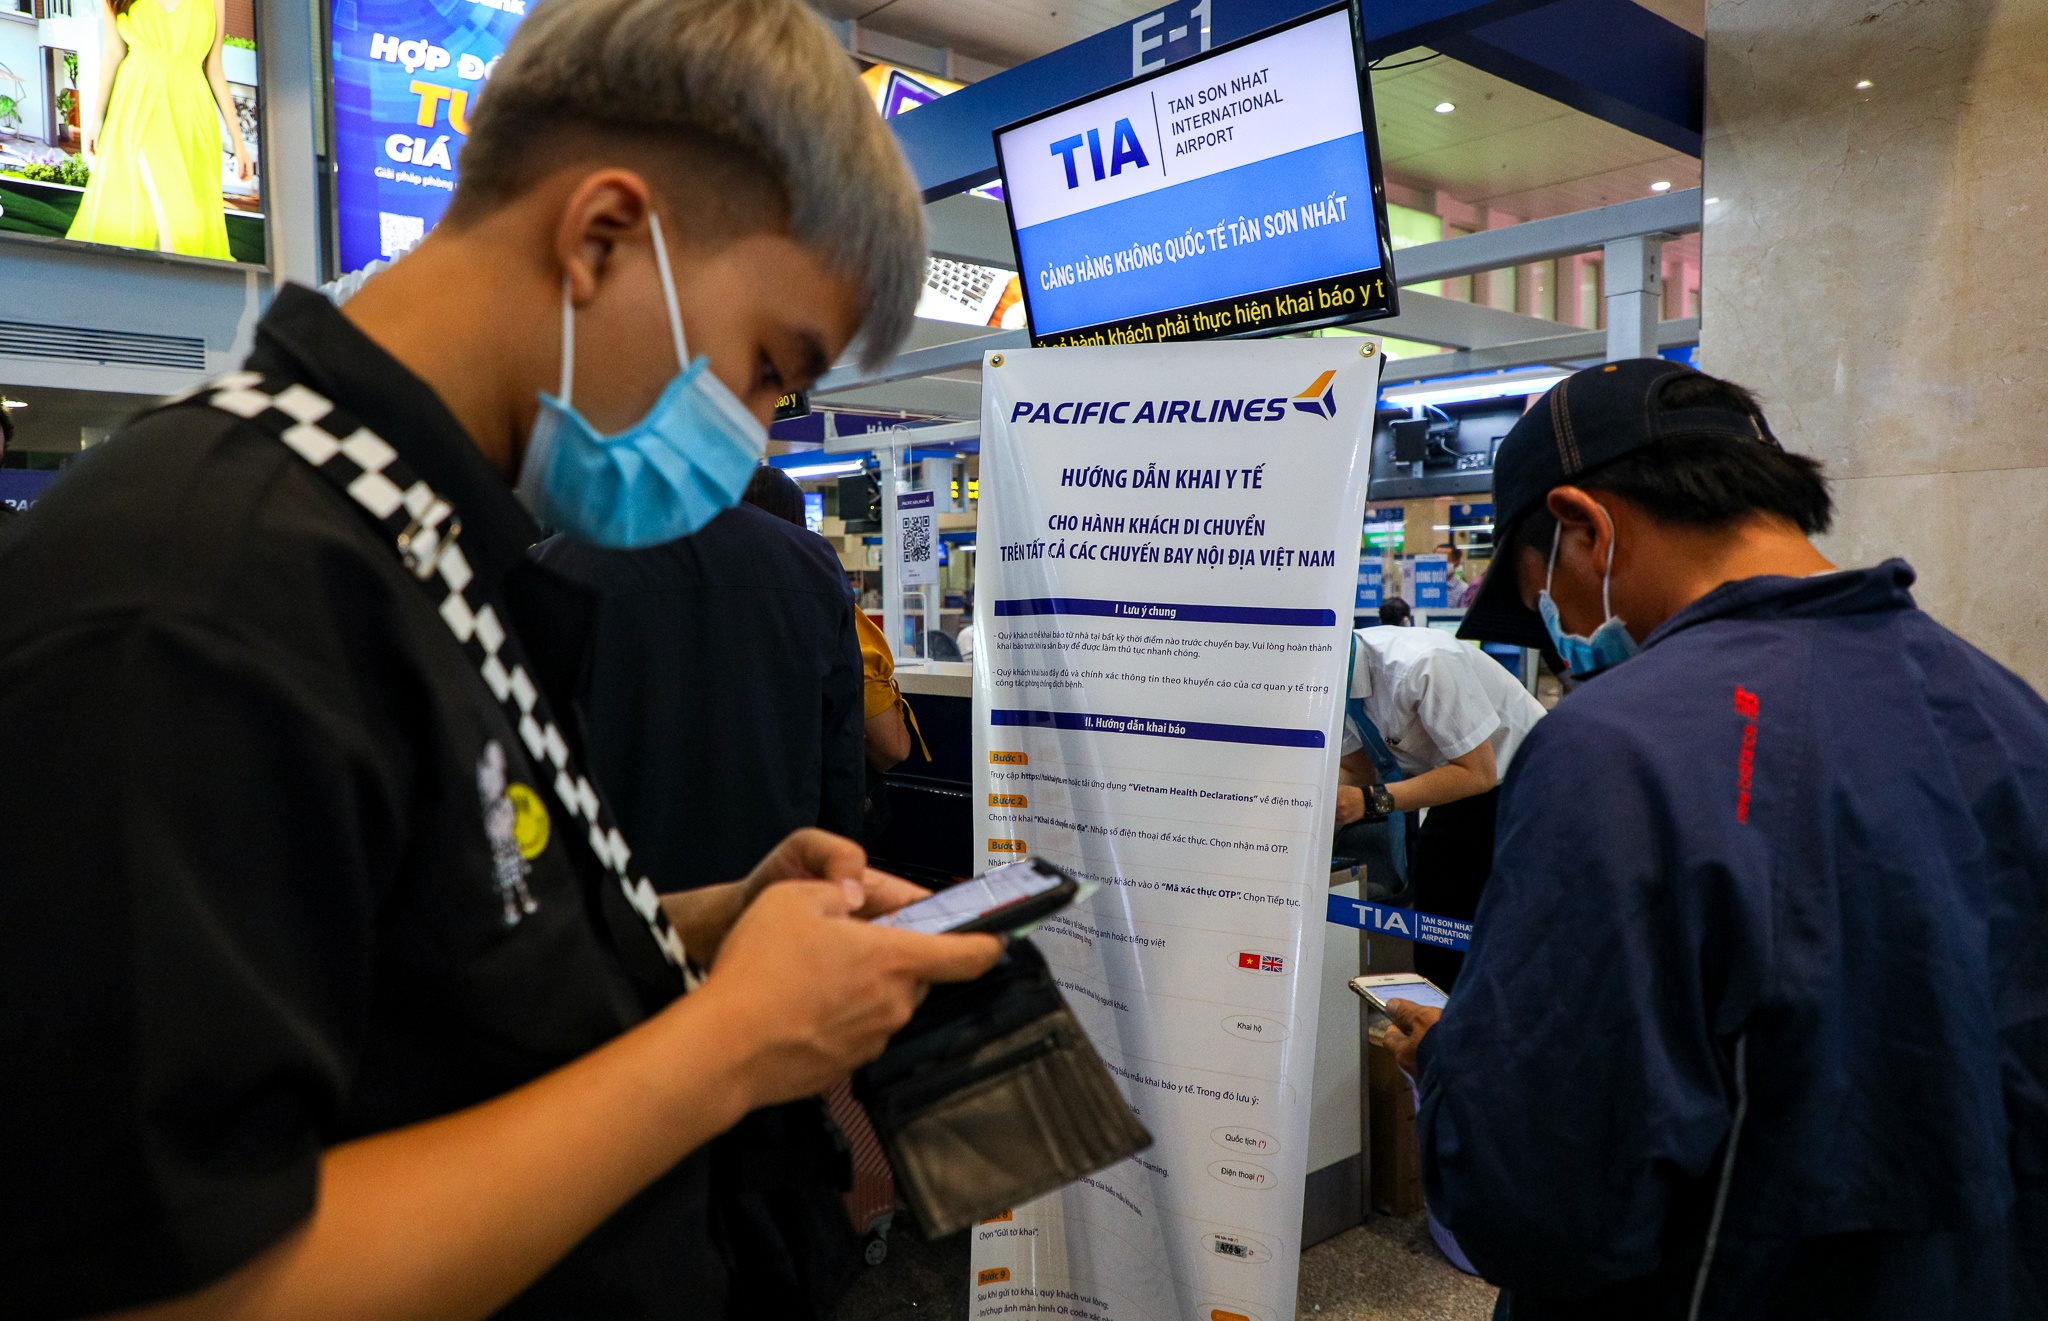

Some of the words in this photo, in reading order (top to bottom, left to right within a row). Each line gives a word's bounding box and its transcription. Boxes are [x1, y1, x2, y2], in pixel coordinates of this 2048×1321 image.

[1132, 0, 1212, 77] E-1
[370, 33, 451, 73] HỢP
[1168, 96, 1195, 115] TAN
[1197, 84, 1227, 105] SON
[1230, 68, 1269, 93] NHAT
[1171, 88, 1284, 136] INTERNATIONAL
[385, 133, 452, 170] GIÁ
[1175, 126, 1234, 157] AIRPORT
[1050, 117, 1149, 190] TIA
[1040, 261, 1075, 291] CẢNG
[1075, 254, 1113, 283] HÀNG
[1115, 241, 1163, 274] KHÔNG
[1165, 225, 1206, 264] QUỐC
[1206, 218, 1228, 251] TẾ
[1228, 215, 1262, 248] TÂN
[1264, 208, 1298, 239] SƠN
[1300, 191, 1348, 231] NHẤT
[1107, 322, 1153, 345] khách
[1156, 315, 1189, 342] phải
[1193, 309, 1231, 334] thực
[1235, 302, 1272, 325] hiện
[1275, 292, 1314, 318] khai
[1319, 285, 1355, 309] báo
[1359, 283, 1370, 306] y
[1010, 401, 1130, 424] PACIFIC
[1132, 398, 1289, 424] AIRLINES
[1061, 466, 1127, 488] HƯỚNG
[1132, 462, 1170, 489] DẪN
[1175, 468, 1221, 489] KHAI
[1225, 470, 1237, 489] Y
[1241, 463, 1266, 489] TẾ
[1048, 515, 1078, 531] CHO
[1082, 513, 1124, 532] HÀNH
[1128, 515, 1179, 535] KHÁCH
[1183, 519, 1199, 535] DI
[1203, 514, 1265, 536] CHUYỂN
[1000, 543, 1025, 562] TRÊN
[1026, 537, 1045, 559] TẤT
[1048, 538, 1065, 559] CẢ
[1069, 541, 1097, 561] CÁC
[1100, 542, 1159, 563] CHUYẾN
[1163, 548, 1194, 564] BAY
[1196, 547, 1224, 570] NỘI
[1228, 549, 1256, 570] ĐỊA
[1259, 547, 1294, 571] VIỆT
[1298, 550, 1336, 567] NAM
[1123, 604, 1140, 615] Lưu
[1149, 605, 1177, 620] chung
[1147, 648, 1172, 656] nhanh
[1165, 638, 1180, 646] nào
[1204, 639, 1233, 650] chuyến
[1252, 642, 1265, 650] Vui
[1267, 642, 1285, 653] lòng
[1286, 643, 1308, 652] hoàn
[1309, 643, 1332, 652] thành
[1081, 670, 1103, 679] chính
[1149, 674, 1159, 683] tin
[1162, 676, 1181, 685] theo
[1216, 678, 1232, 688] cáo
[1233, 679, 1249, 690] của
[1264, 682, 1286, 692] quan
[1096, 717, 1124, 732] Hướng
[1127, 719, 1145, 732] dẫn
[1146, 721, 1166, 733] khai
[1168, 723, 1186, 735] báo
[1170, 786, 1198, 798] Health
[1138, 830, 1159, 841] thoại
[1210, 838, 1232, 848] Chọn
[1233, 841, 1254, 851] nhận
[1138, 880, 1153, 890] vào
[1181, 884, 1195, 894] xác
[1197, 887, 1217, 898] thực
[1243, 892, 1265, 903] Chọn
[1267, 894, 1285, 906] Tiếp
[1352, 903, 1410, 935] TIA
[1421, 915, 1436, 925] TAN
[1437, 918, 1453, 928] SON
[1454, 922, 1473, 932] NHAT
[1421, 933, 1454, 945] AIRPORT
[1237, 1021, 1253, 1032] Khai
[1253, 1024, 1262, 1034] hộ
[1161, 1080, 1177, 1091] báo
[1197, 1086, 1221, 1100] Trong
[1222, 1091, 1235, 1101] đó
[1236, 1092, 1250, 1103] lưu
[1225, 1133, 1244, 1144] Quốc
[1244, 1136, 1257, 1147] tịch
[1221, 1167, 1237, 1178] Điện
[1238, 1170, 1256, 1181] thoại
[1056, 1289, 1079, 1300] khách
[1037, 1304, 1055, 1313] hình
[1057, 1306, 1069, 1316] QR
[1070, 1308, 1088, 1319] code
